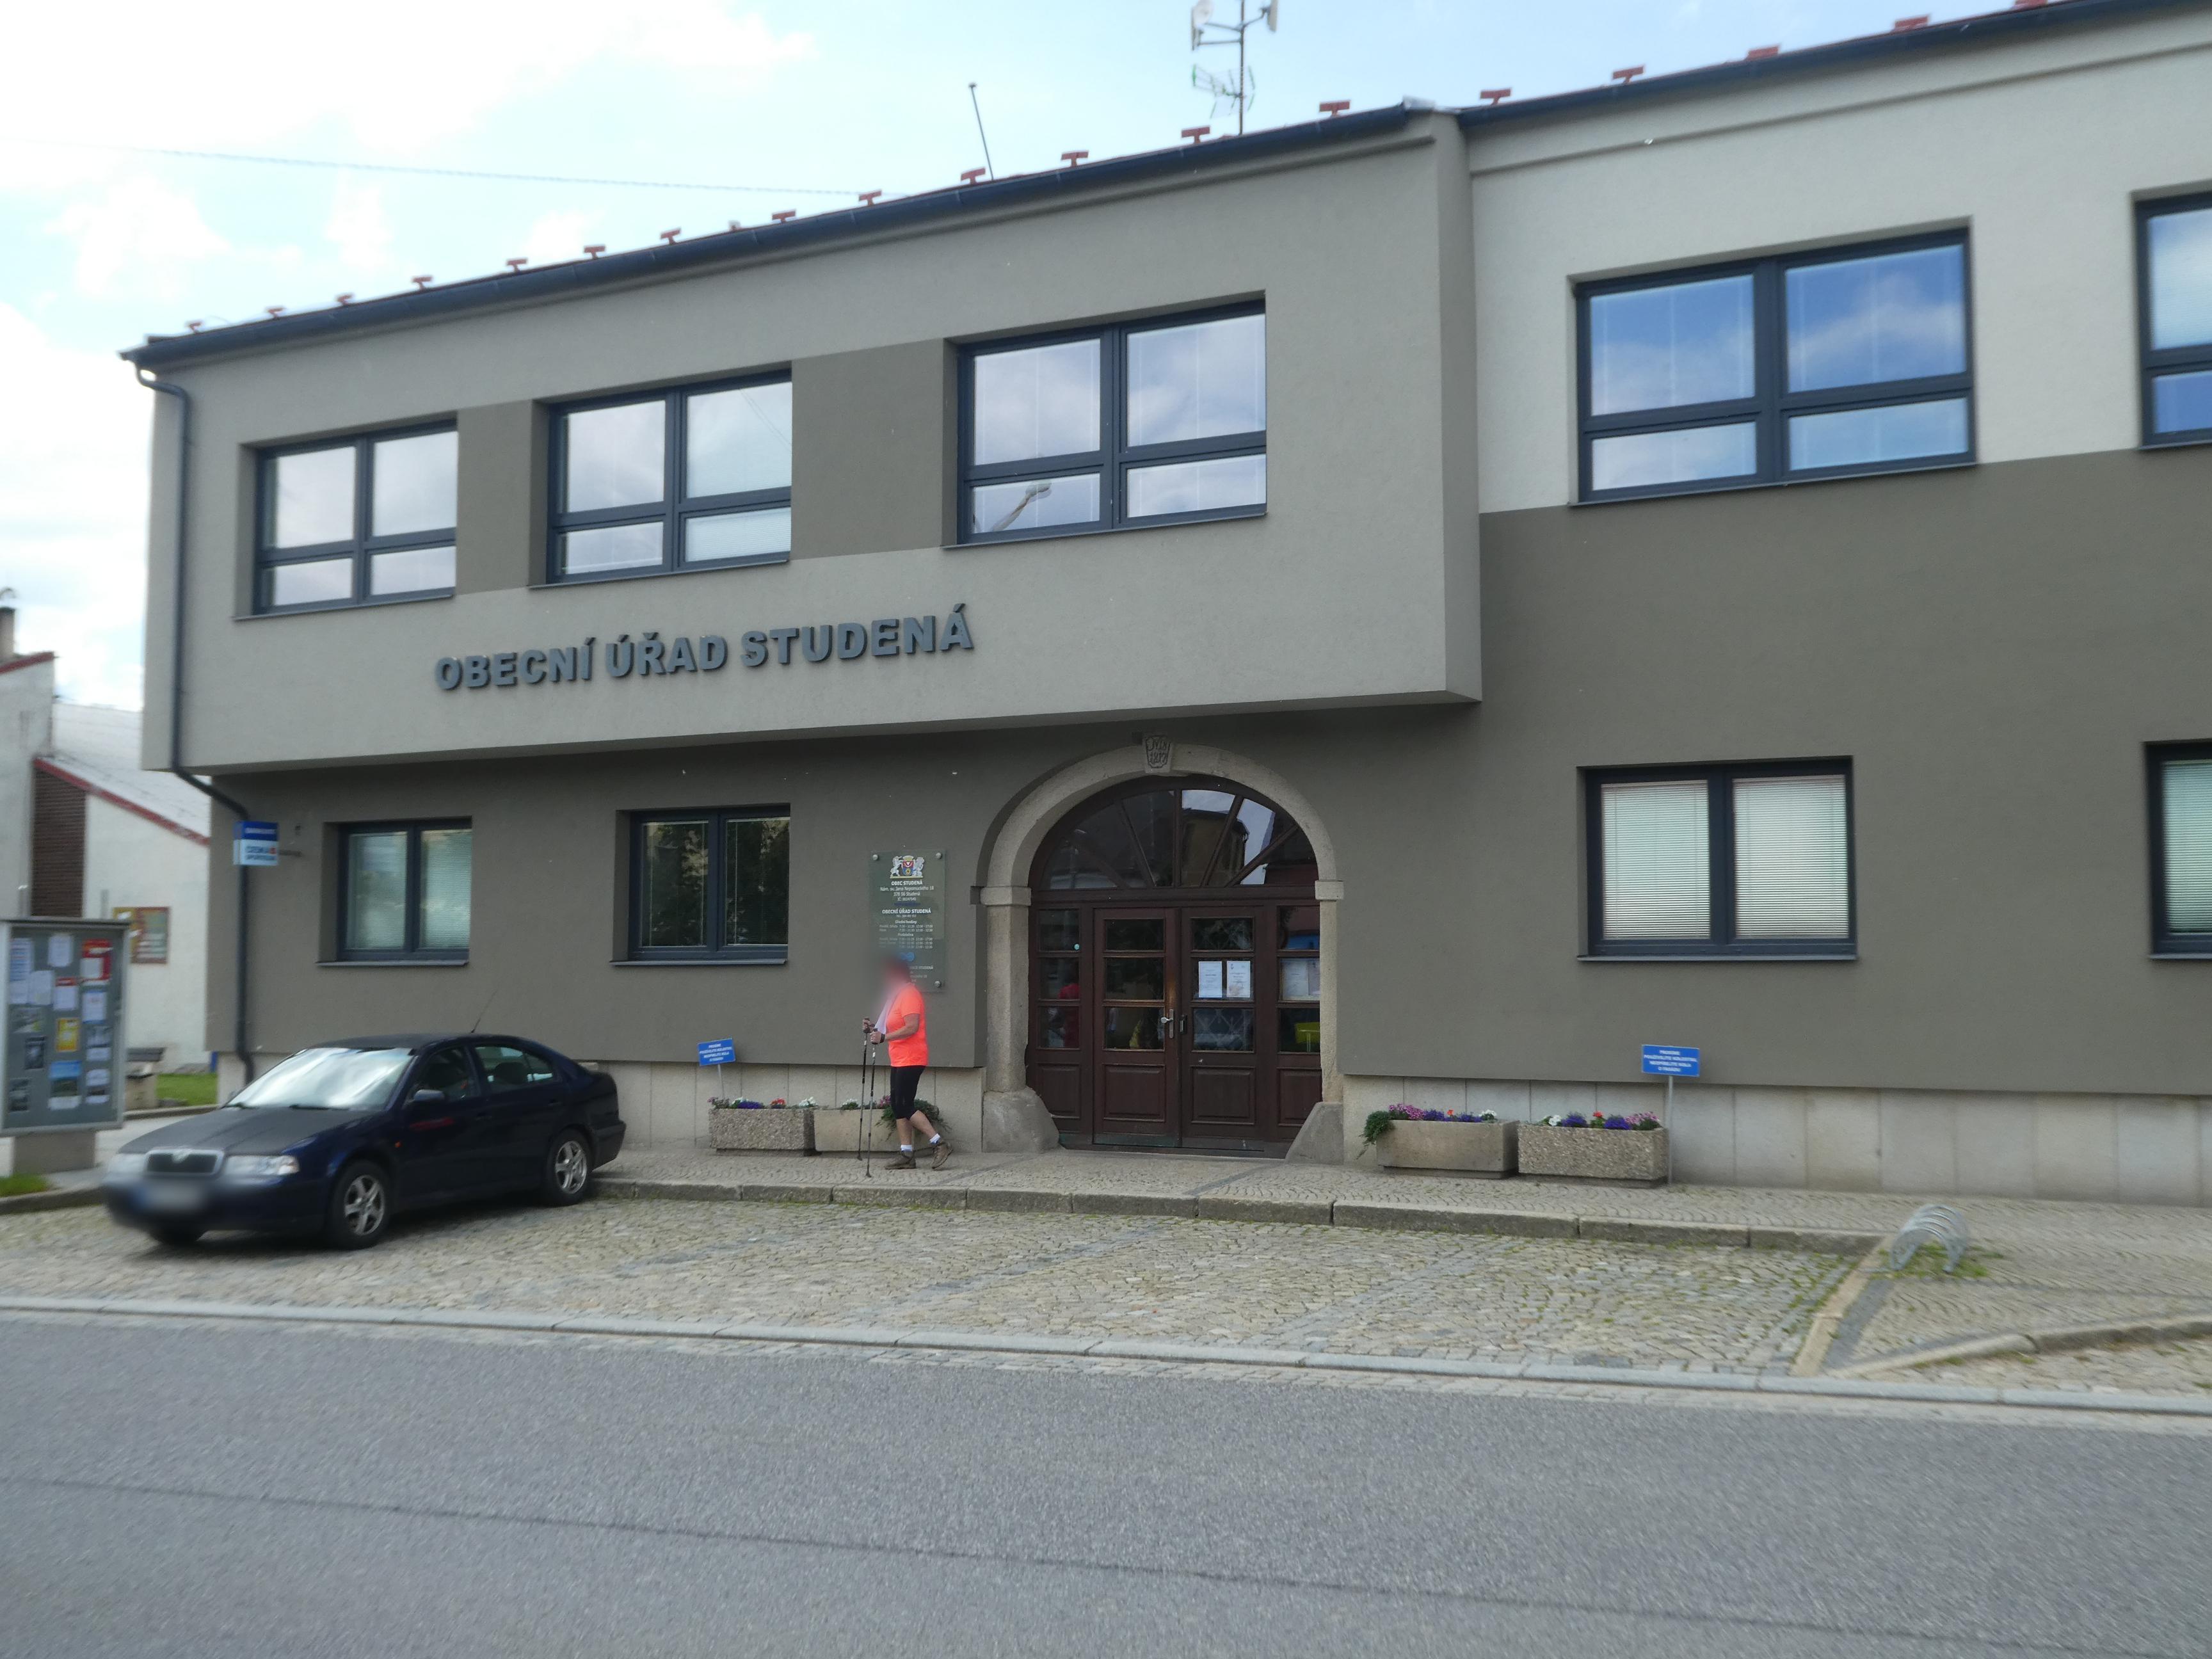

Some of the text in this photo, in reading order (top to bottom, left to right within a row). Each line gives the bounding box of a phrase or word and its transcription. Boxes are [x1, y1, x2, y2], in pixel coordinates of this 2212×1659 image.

[435, 603, 974, 690] OBECNÍ ÚŘAD STUDENÁ
